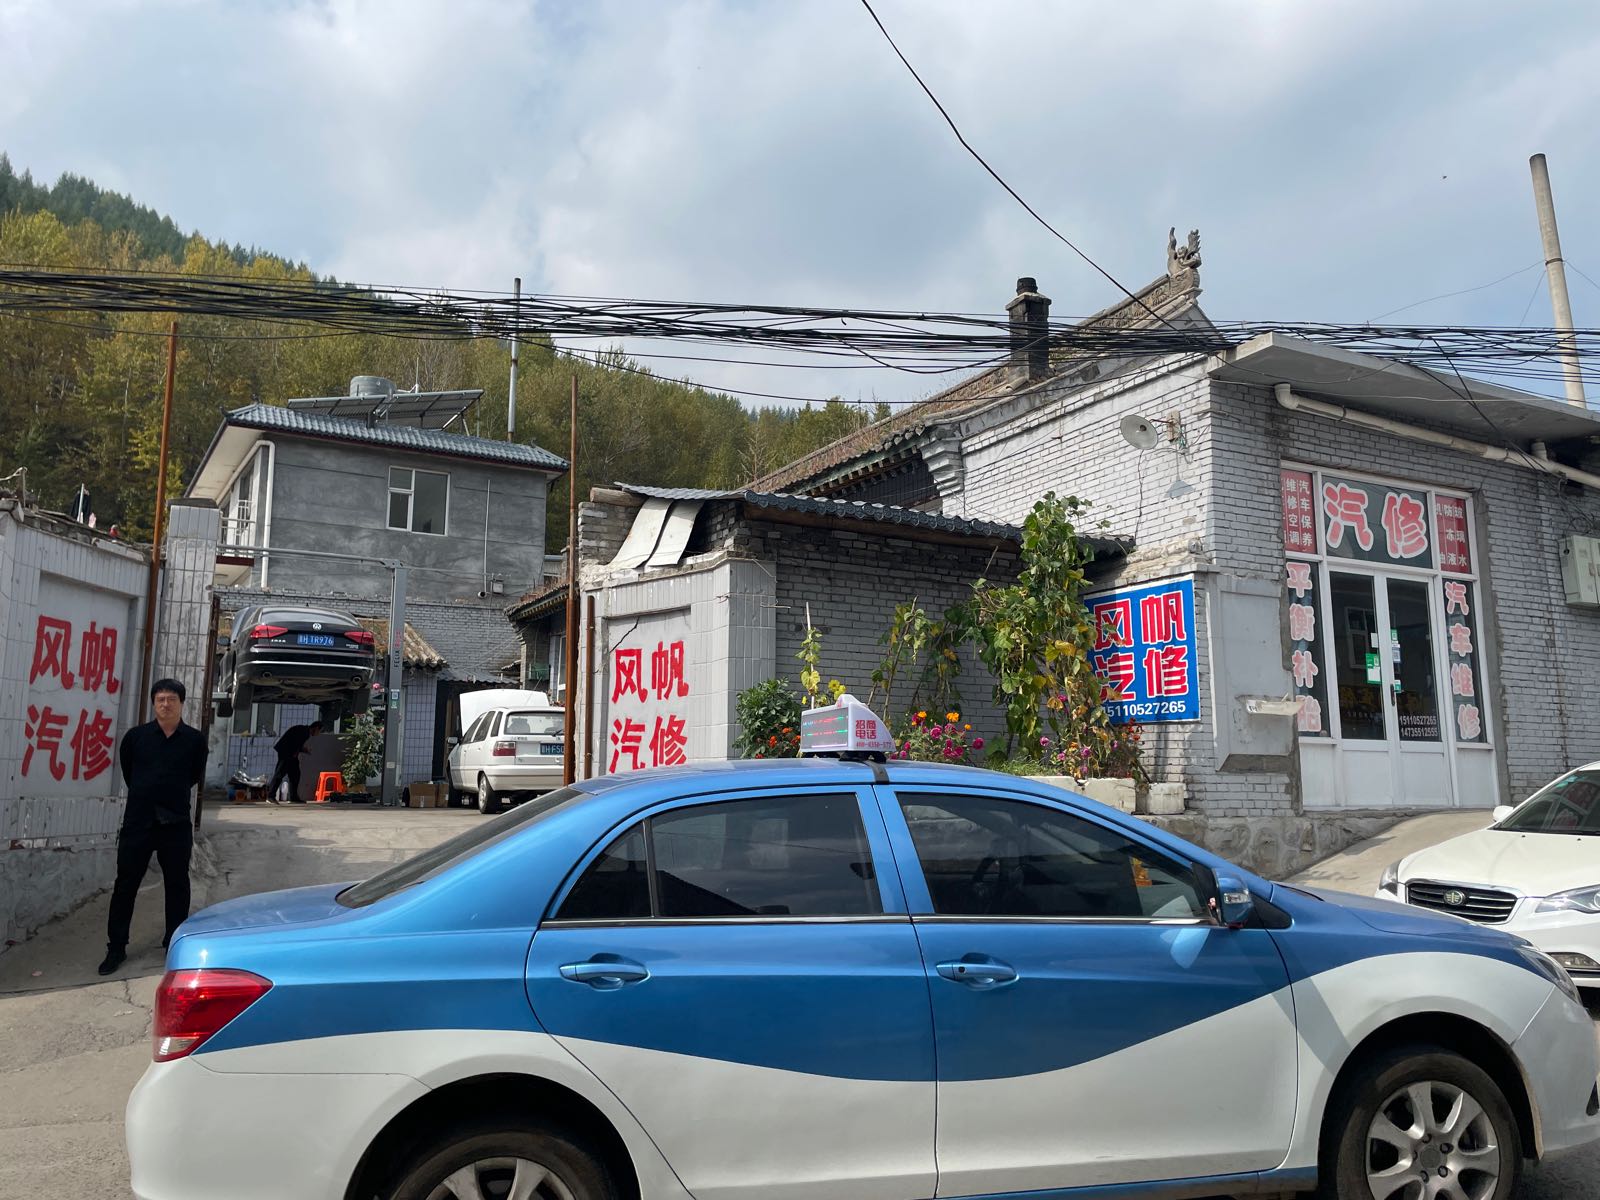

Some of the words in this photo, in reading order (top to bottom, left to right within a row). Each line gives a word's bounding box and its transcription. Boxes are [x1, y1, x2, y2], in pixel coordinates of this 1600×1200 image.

[1286, 478, 1300, 545] 维修空调
[1299, 480, 1313, 546] 汽车保养
[1323, 482, 1428, 558] 汽修
[1454, 506, 1467, 566] 玻璃水
[298, 633, 333, 645] HTR976
[1093, 590, 1187, 652] 风帆
[1286, 562, 1322, 732] 平衡补胎
[29, 615, 120, 695] 风帆
[612, 640, 689, 704] 风帆
[1094, 645, 1189, 702] 汽修
[1445, 581, 1481, 739] 汽车维修
[21, 704, 113, 781] 汽修
[609, 715, 688, 774] 汽修
[856, 730, 876, 739] 电话
[1399, 715, 1436, 726] 15110527265
